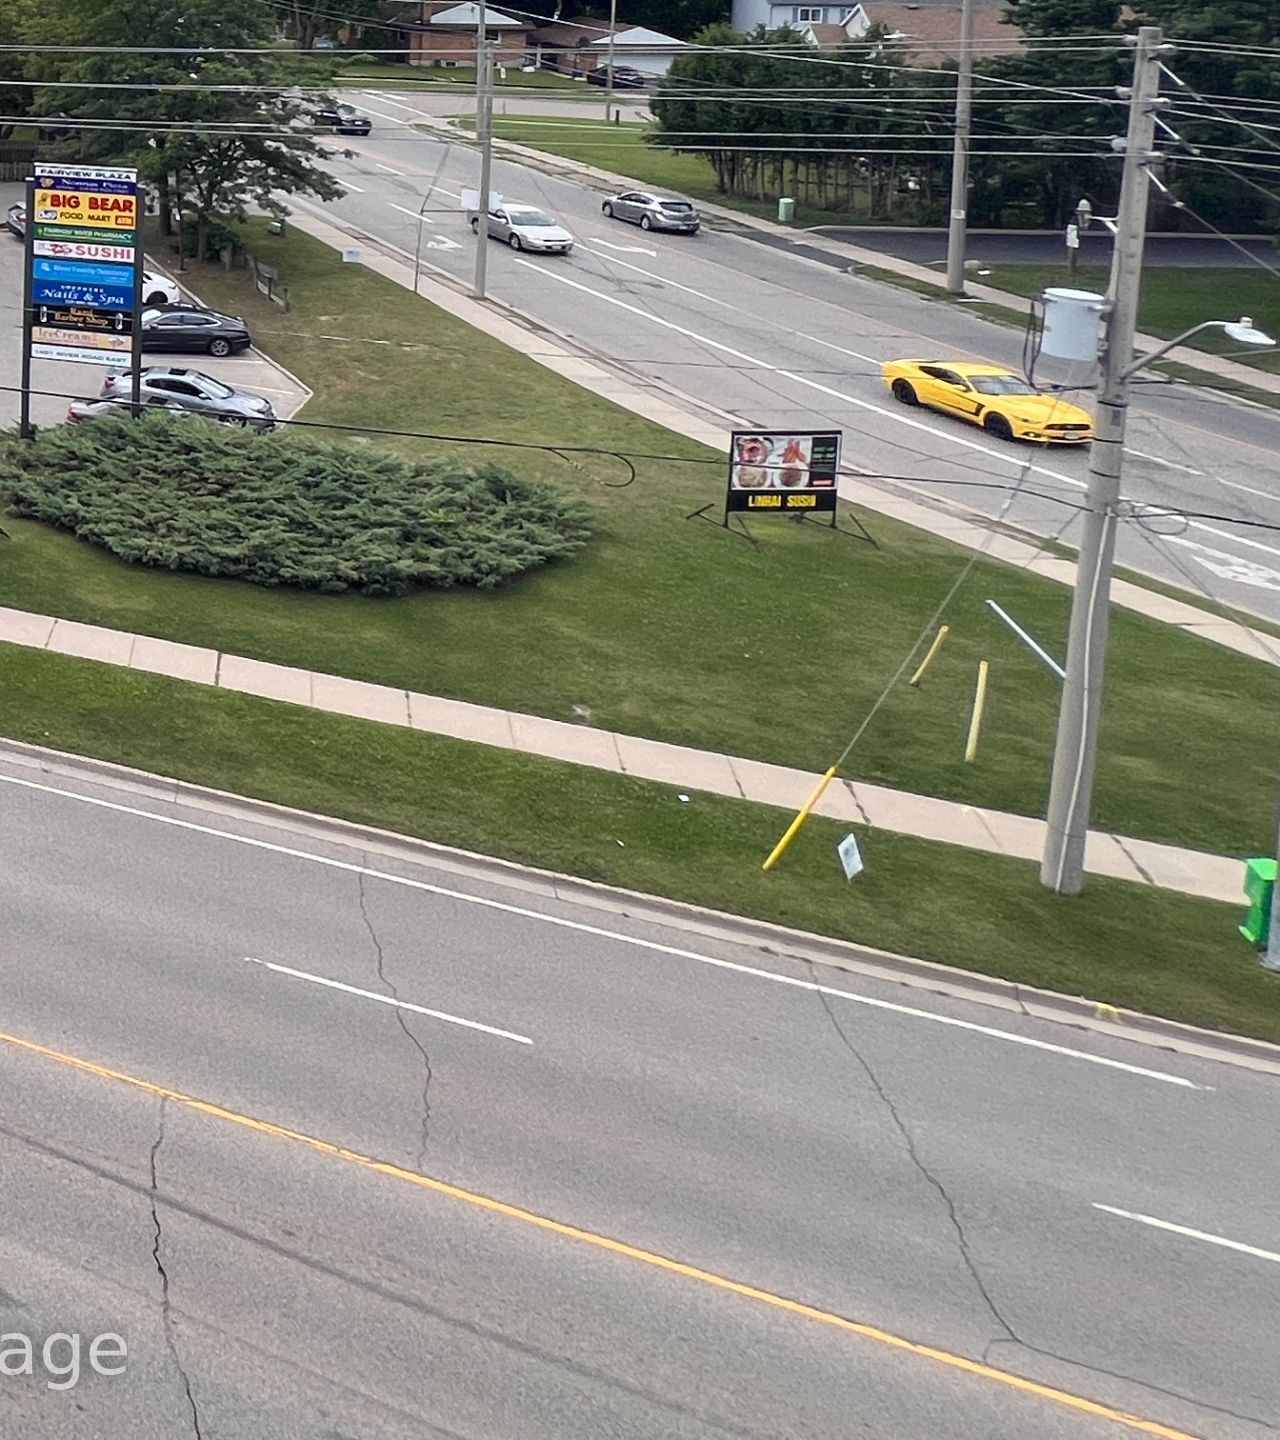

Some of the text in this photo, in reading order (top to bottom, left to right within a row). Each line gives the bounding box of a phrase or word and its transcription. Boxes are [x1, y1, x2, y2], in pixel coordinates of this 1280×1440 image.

[40, 168, 132, 180] FAIRVIEW PLAZA
[50, 194, 134, 213] BIG BEAR
[60, 211, 83, 220] FOOD
[87, 213, 111, 222] MART
[94, 231, 132, 239] PHARMACY
[75, 245, 131, 259] SUSHI
[40, 289, 79, 300] Nails
[83, 292, 94, 301] &
[98, 293, 125, 305] Spa
